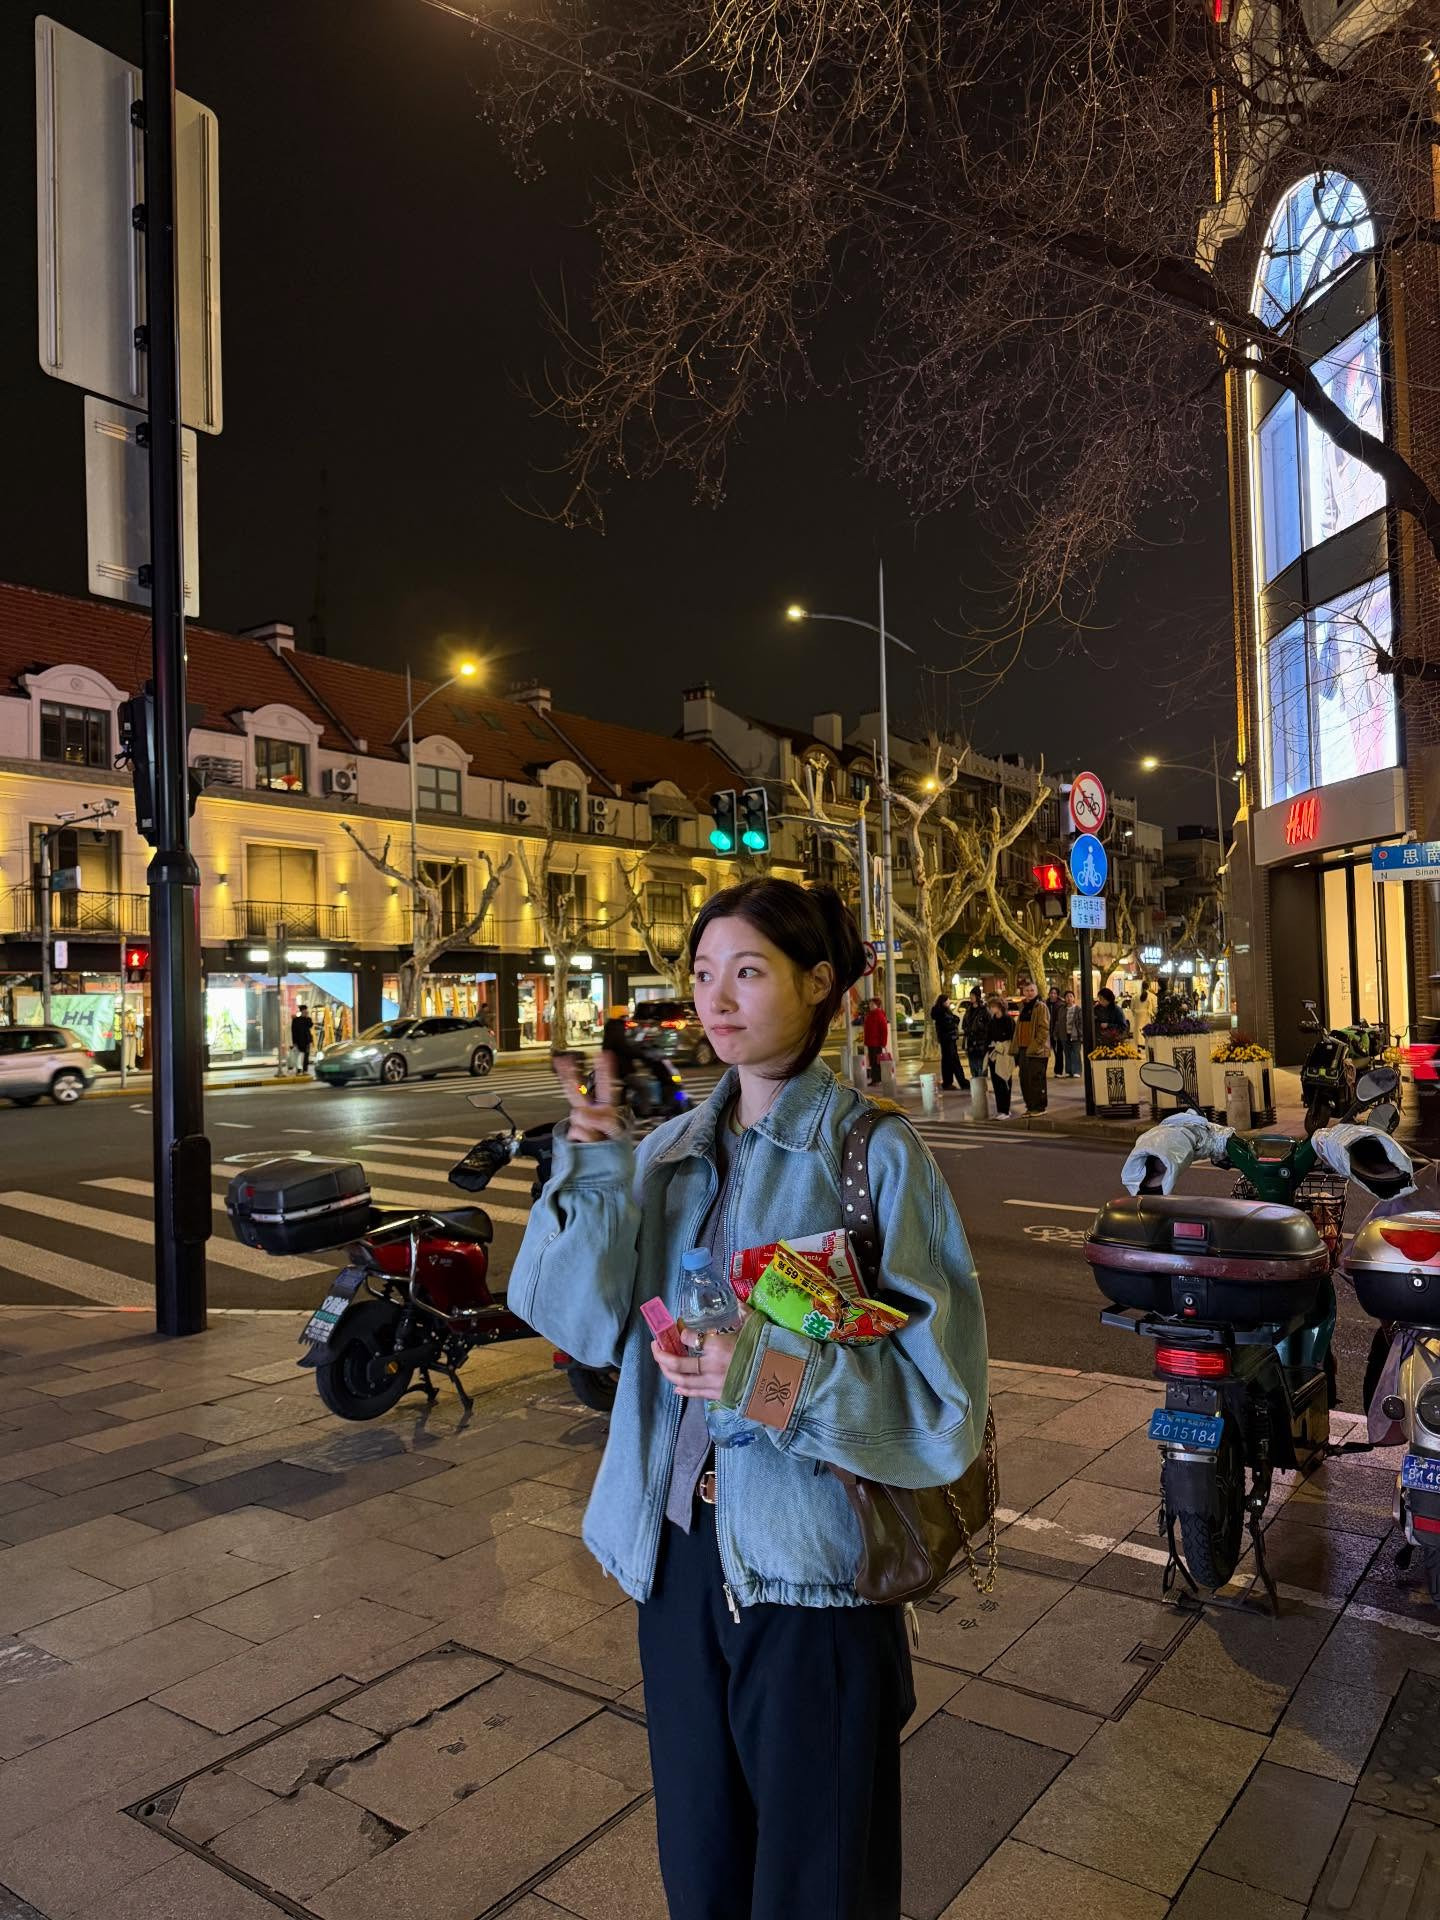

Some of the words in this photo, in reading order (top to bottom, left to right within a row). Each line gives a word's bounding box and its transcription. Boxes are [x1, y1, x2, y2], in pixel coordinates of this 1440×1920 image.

[1286, 797, 1317, 845] H&M
[1402, 847, 1440, 865] 思南
[1380, 871, 1388, 880] N
[1415, 868, 1439, 876] Sinan
[61, 1010, 95, 1025] HH
[1152, 1422, 1217, 1445] Z015184
